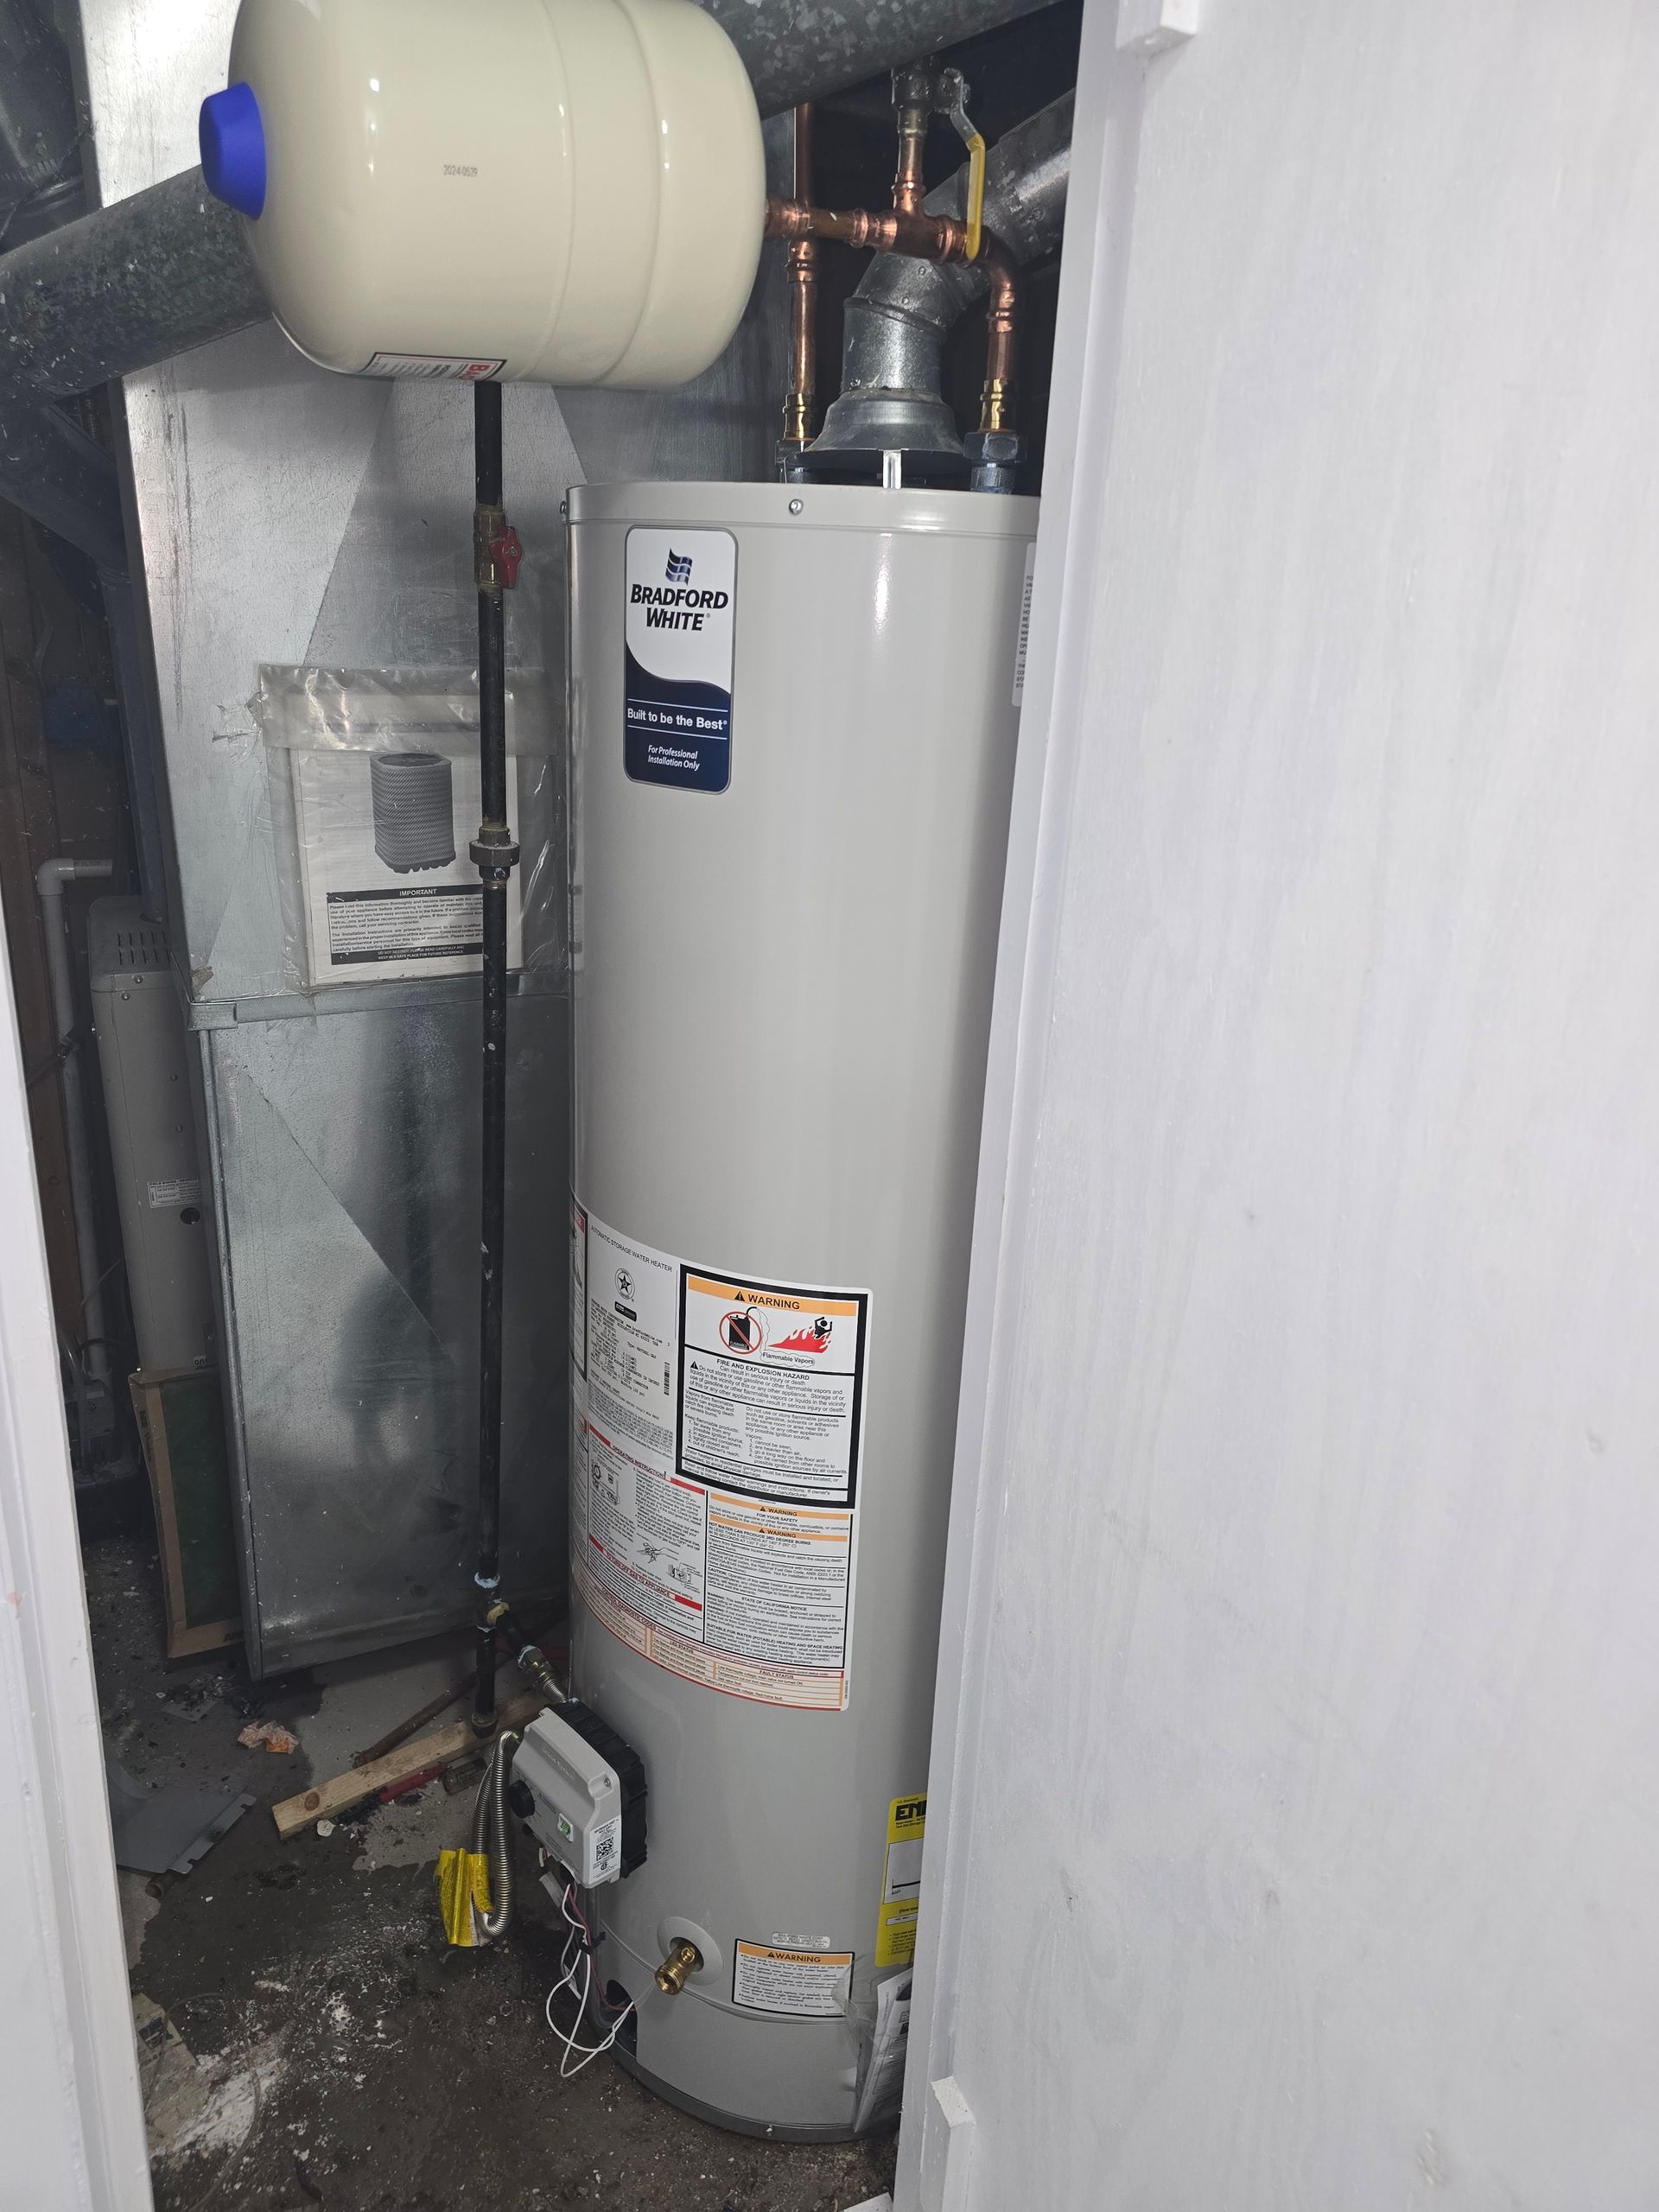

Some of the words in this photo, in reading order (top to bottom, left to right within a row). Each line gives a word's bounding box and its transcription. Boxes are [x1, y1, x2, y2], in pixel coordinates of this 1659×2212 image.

[631, 584, 728, 609] BRADFORD
[627, 708, 646, 721] Built
[648, 712, 658, 722] to
[660, 713, 673, 724] be
[676, 715, 693, 727] the
[648, 745, 658, 753] For
[658, 747, 698, 760] Professional
[648, 754, 683, 767] Installation
[683, 760, 700, 771] Only
[632, 1252, 650, 1263] WATER
[651, 1260, 672, 1272] HEATER
[748, 1294, 799, 1309] WARNING
[762, 1352, 792, 1362] Flammable
[746, 1365, 781, 1376] EXPLOSION
[768, 1508, 798, 1516] WARNING
[767, 1529, 797, 1538] WARNING
[775, 1953, 821, 1963] WARNING
